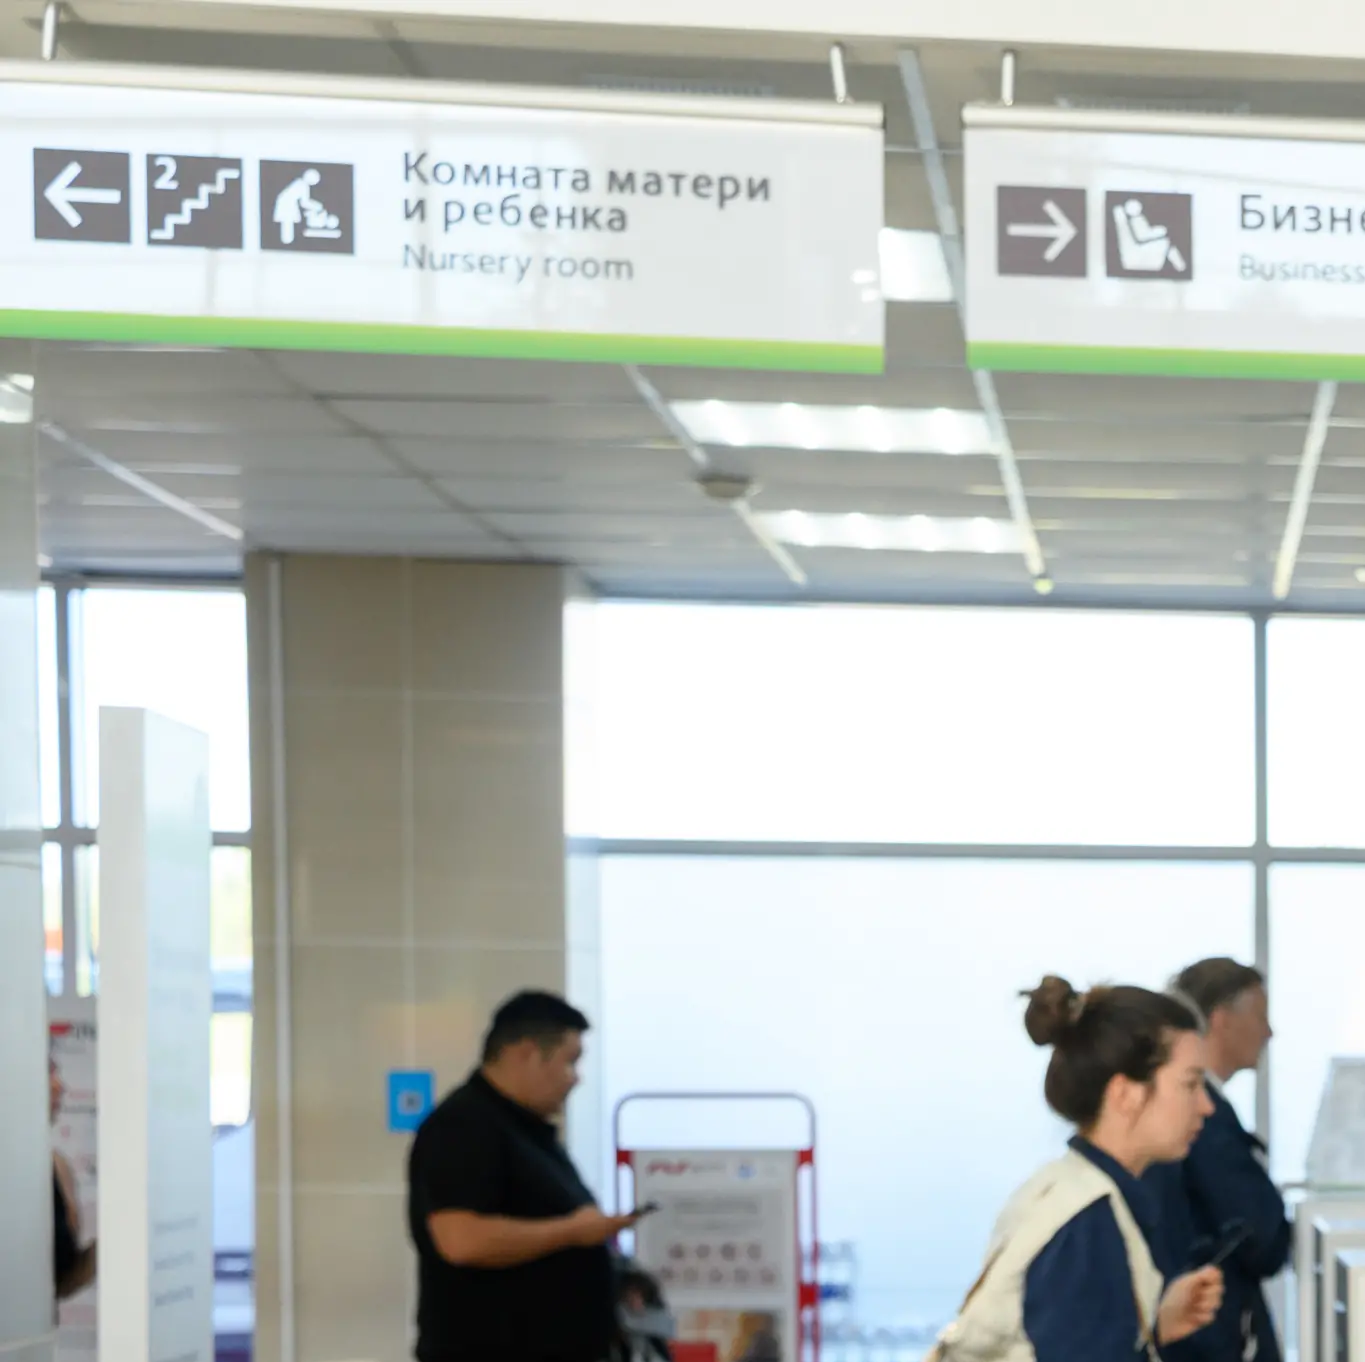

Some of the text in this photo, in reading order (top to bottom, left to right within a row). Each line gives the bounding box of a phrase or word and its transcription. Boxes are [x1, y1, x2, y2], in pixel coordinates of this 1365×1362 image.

[154, 156, 179, 190] 2
[402, 150, 772, 206] Комната матери
[403, 194, 629, 233] и ребенка
[402, 244, 635, 284] Nursery room
